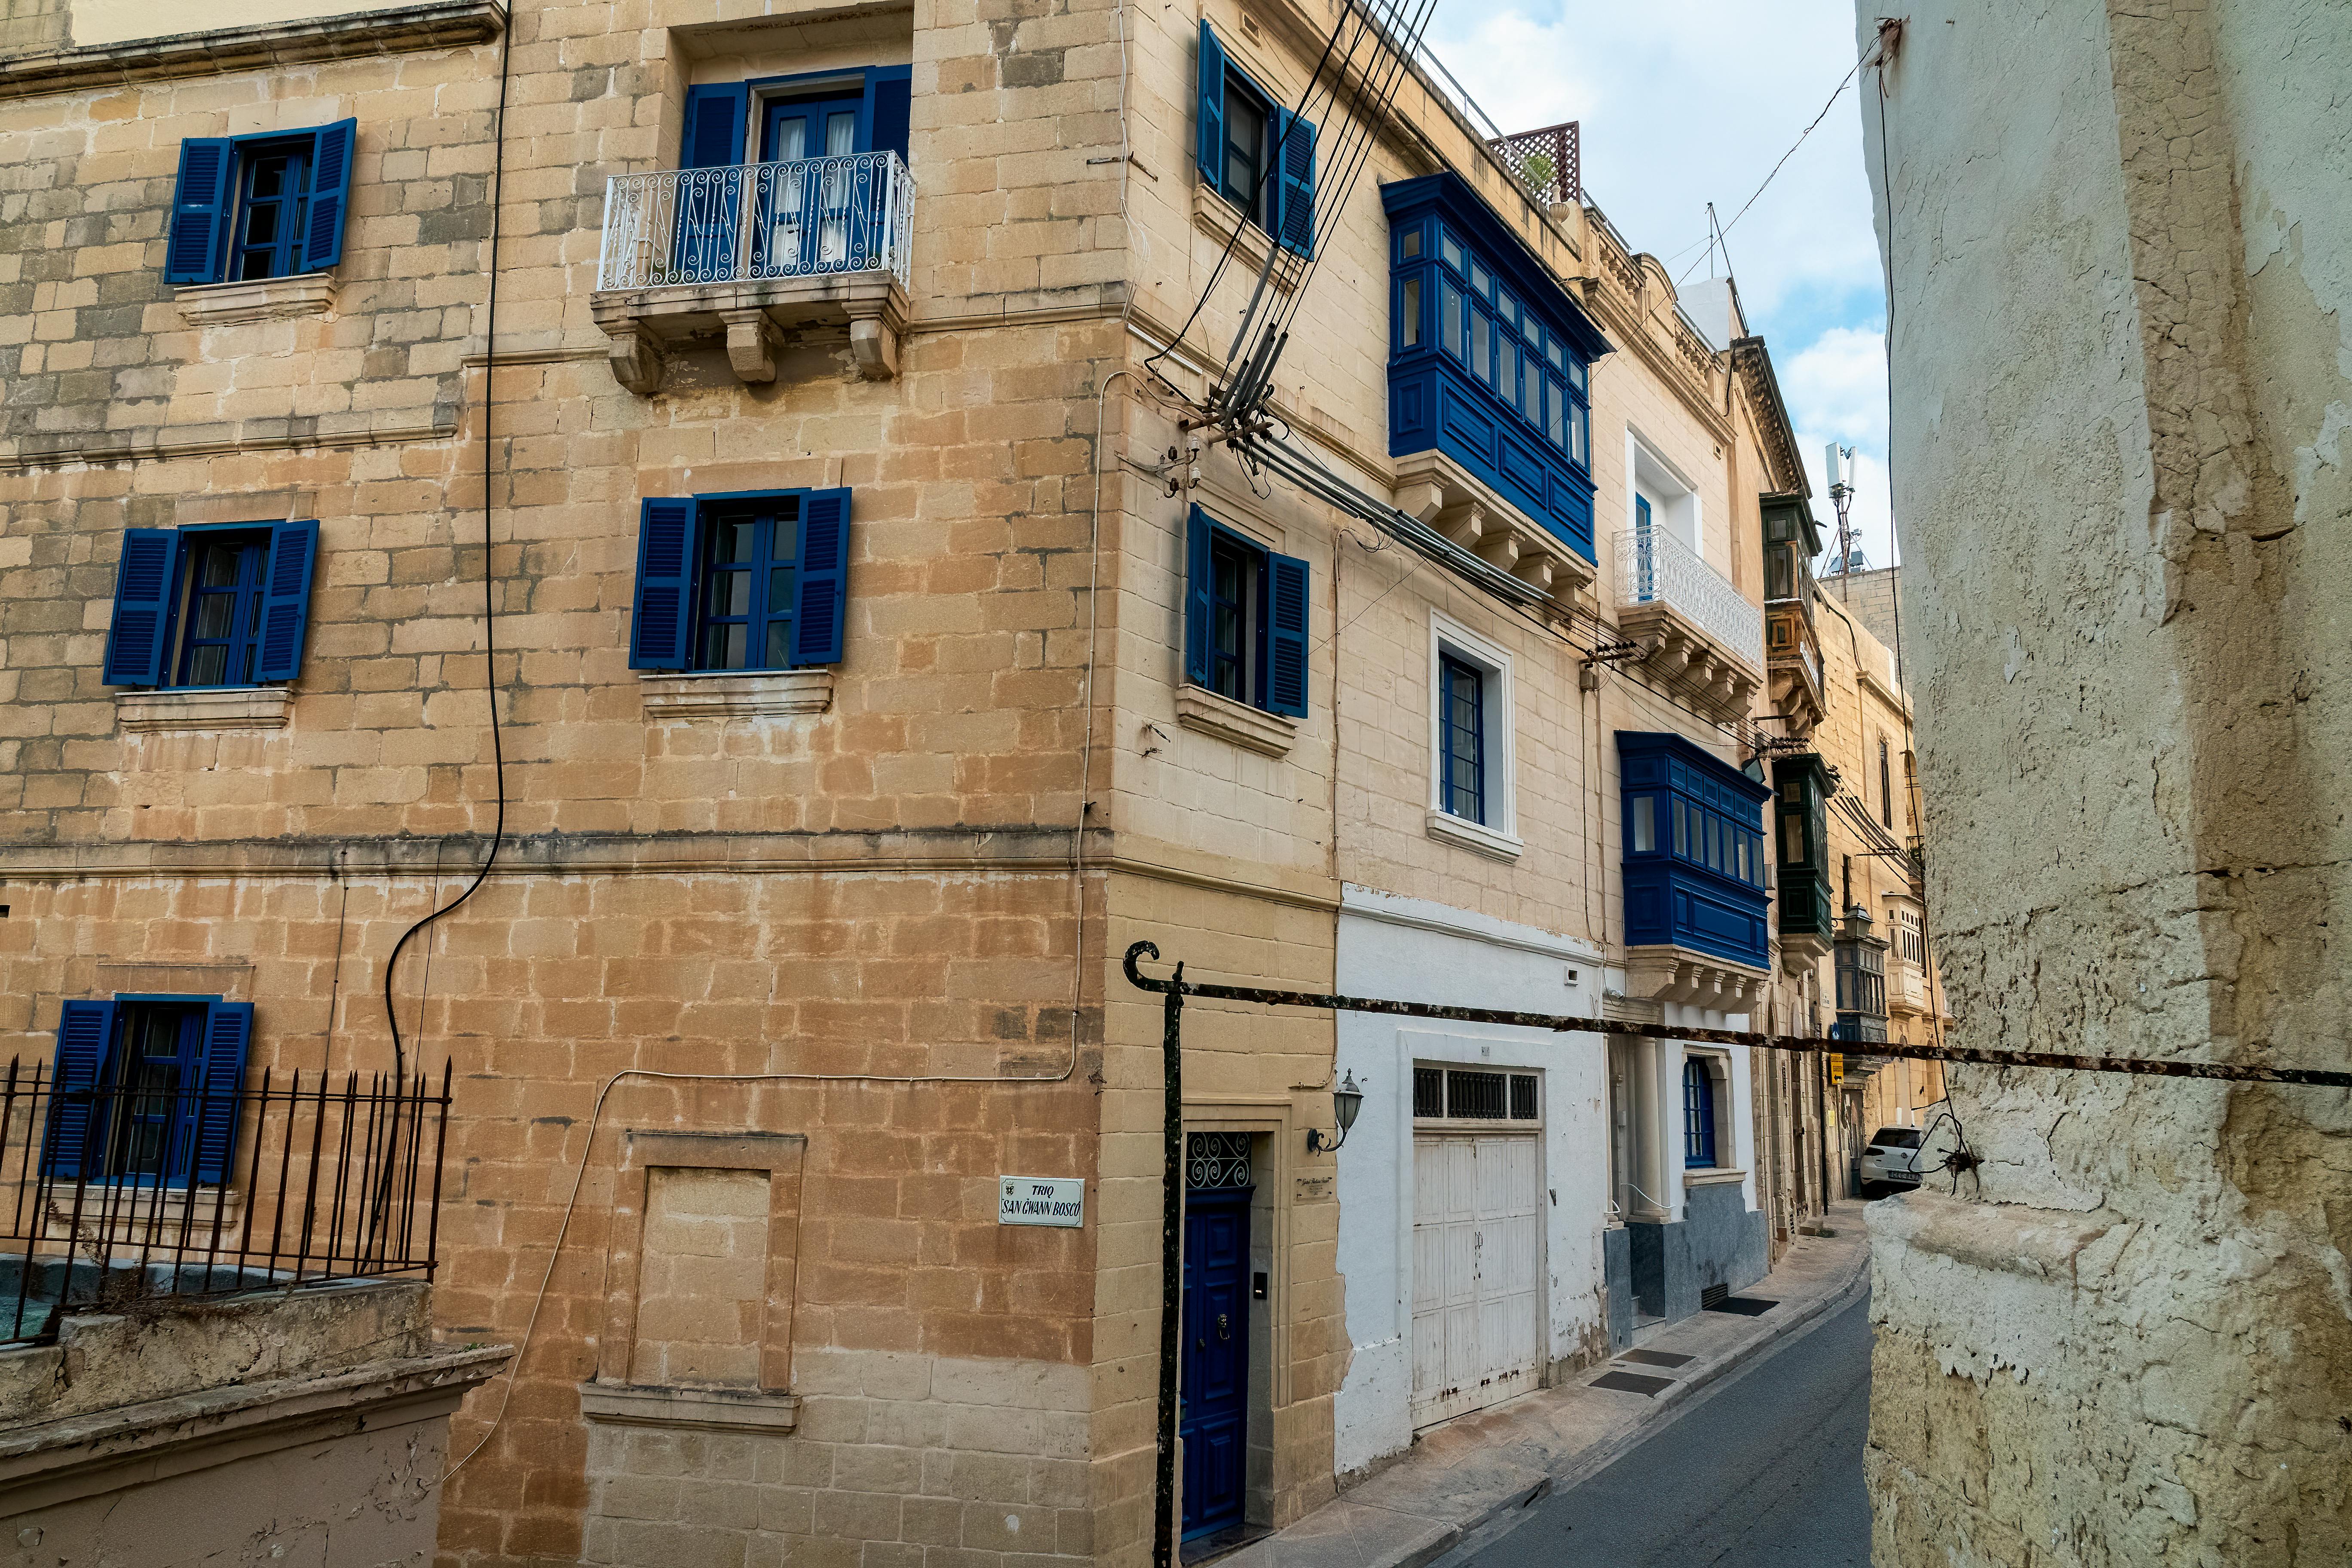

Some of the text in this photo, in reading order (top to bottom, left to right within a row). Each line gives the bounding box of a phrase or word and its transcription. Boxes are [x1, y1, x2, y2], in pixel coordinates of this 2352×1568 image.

[1032, 1185, 1054, 1198] TRIQ
[1002, 1200, 1022, 1214] SAN
[1052, 1201, 1080, 1217] BOSCO
